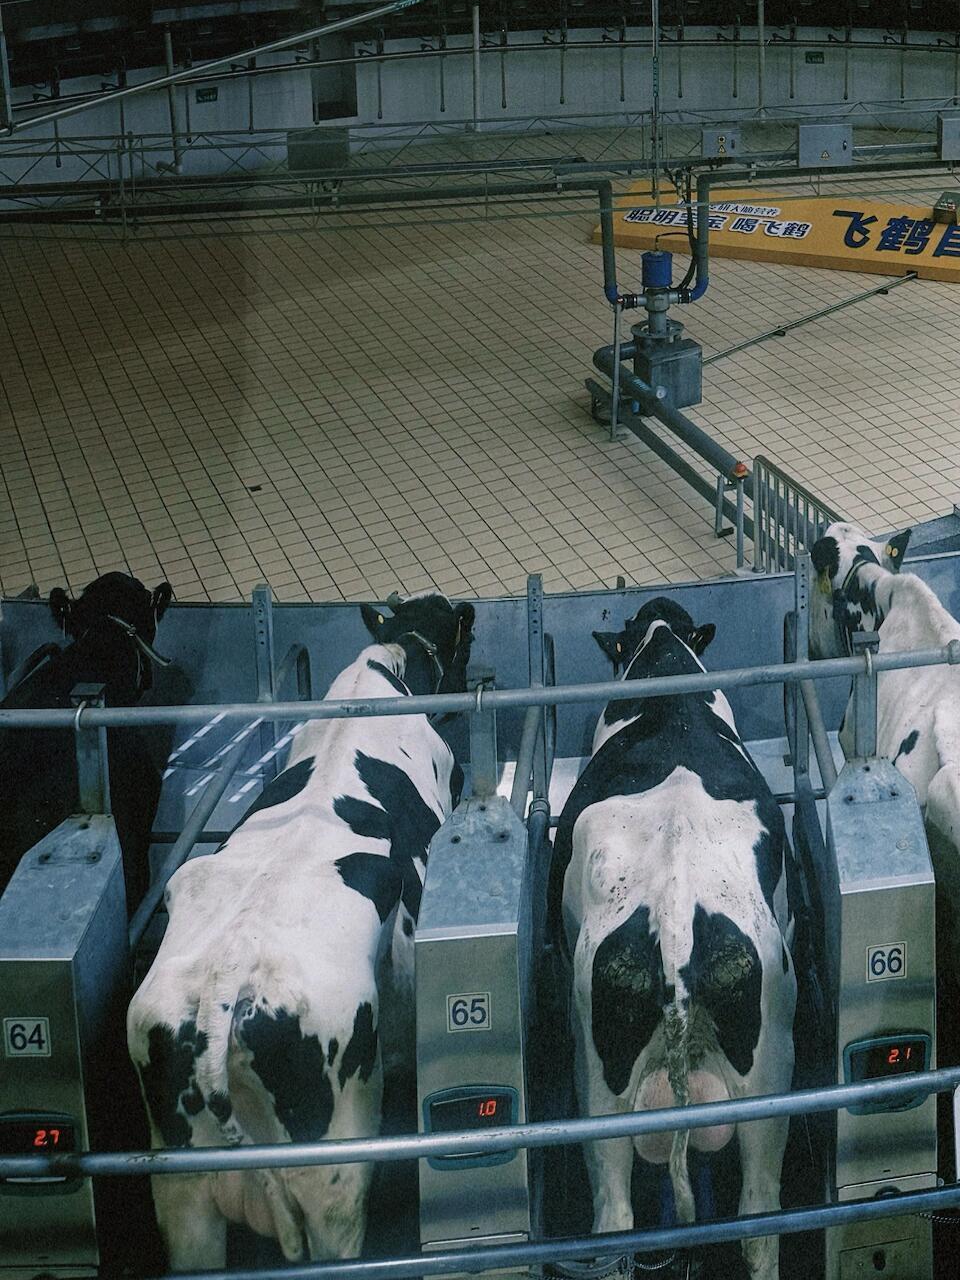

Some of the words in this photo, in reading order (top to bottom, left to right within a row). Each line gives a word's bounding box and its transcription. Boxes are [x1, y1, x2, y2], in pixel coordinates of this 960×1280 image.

[733, 217, 811, 238] 喝飞鹤
[871, 948, 902, 975] 66
[452, 999, 487, 1026] 65
[10, 1024, 45, 1051] 64
[888, 1048, 912, 1063] 2.1
[34, 1130, 60, 1146] 2.7
